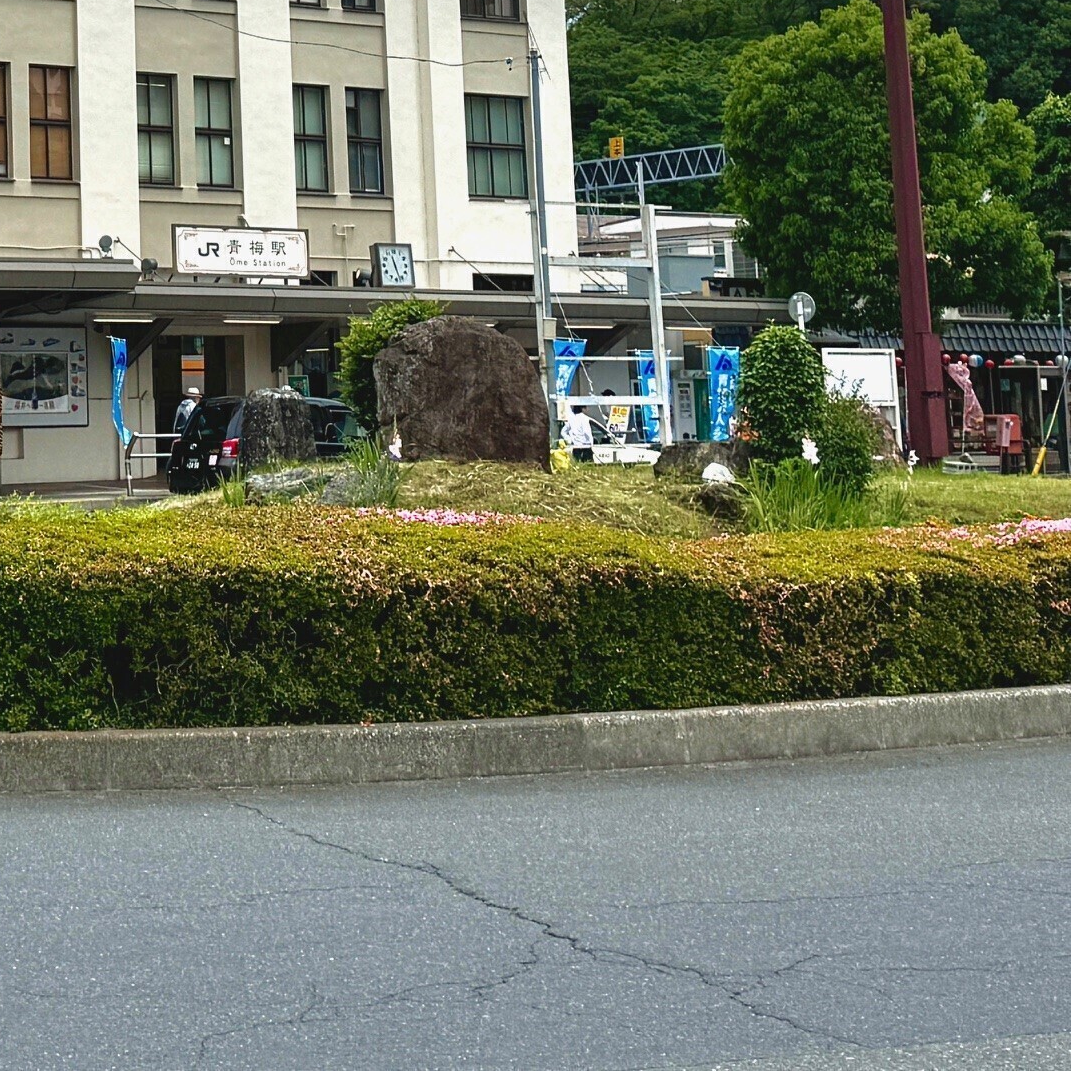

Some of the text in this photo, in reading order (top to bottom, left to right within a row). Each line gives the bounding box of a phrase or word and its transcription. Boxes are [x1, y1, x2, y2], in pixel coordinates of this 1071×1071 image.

[198, 242, 220, 257] JR
[227, 239, 286, 256] 青梅駅
[253, 259, 286, 267] Station
